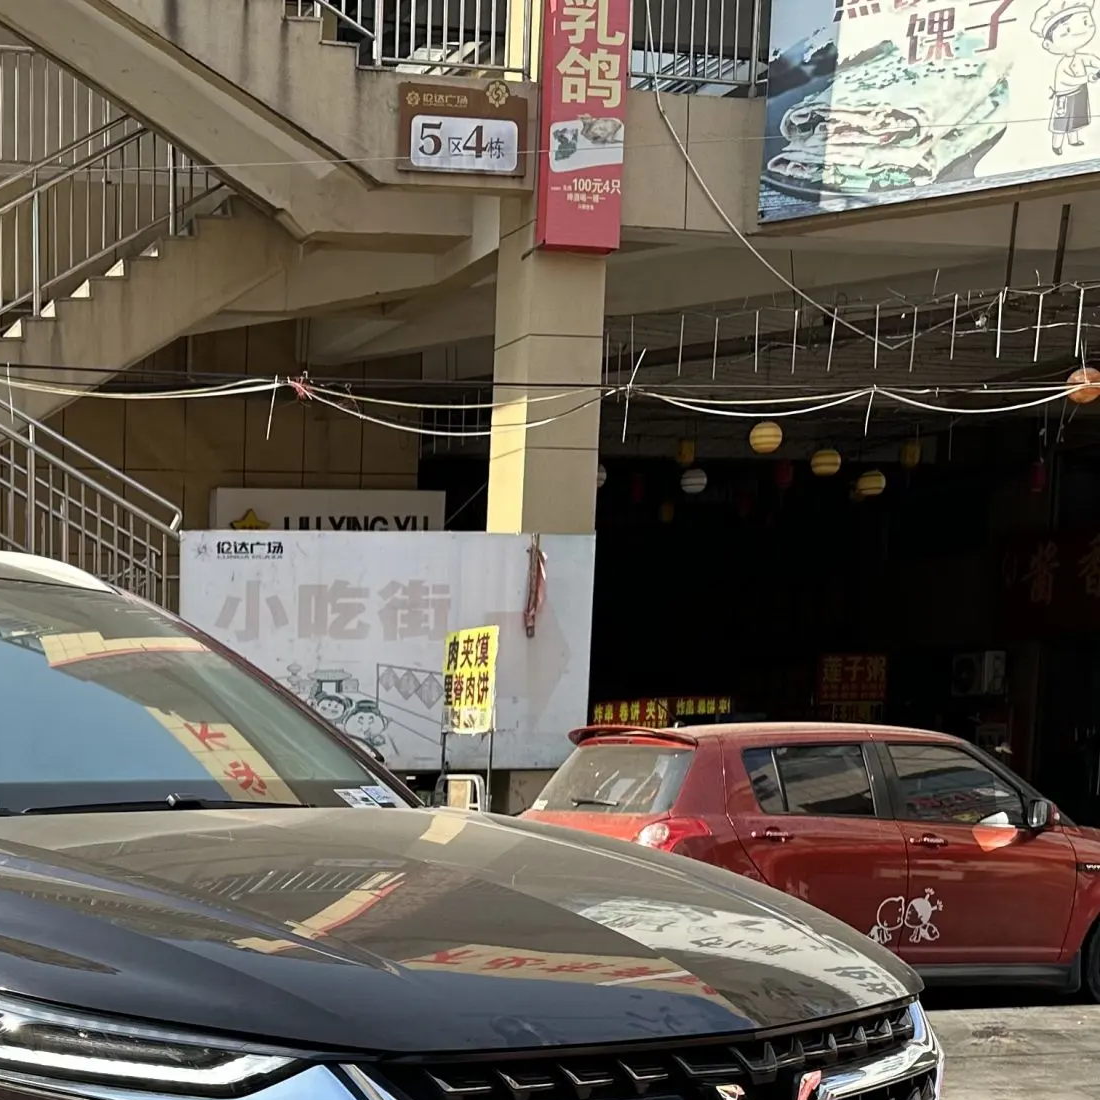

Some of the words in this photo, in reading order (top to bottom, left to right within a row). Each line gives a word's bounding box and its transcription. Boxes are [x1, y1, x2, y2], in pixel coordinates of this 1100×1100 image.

[216, 541, 284, 554] 伦达广场
[214, 579, 452, 642] 小吃街
[447, 632, 490, 670] 肉夹馍
[444, 670, 489, 706] 里脊肉饼
